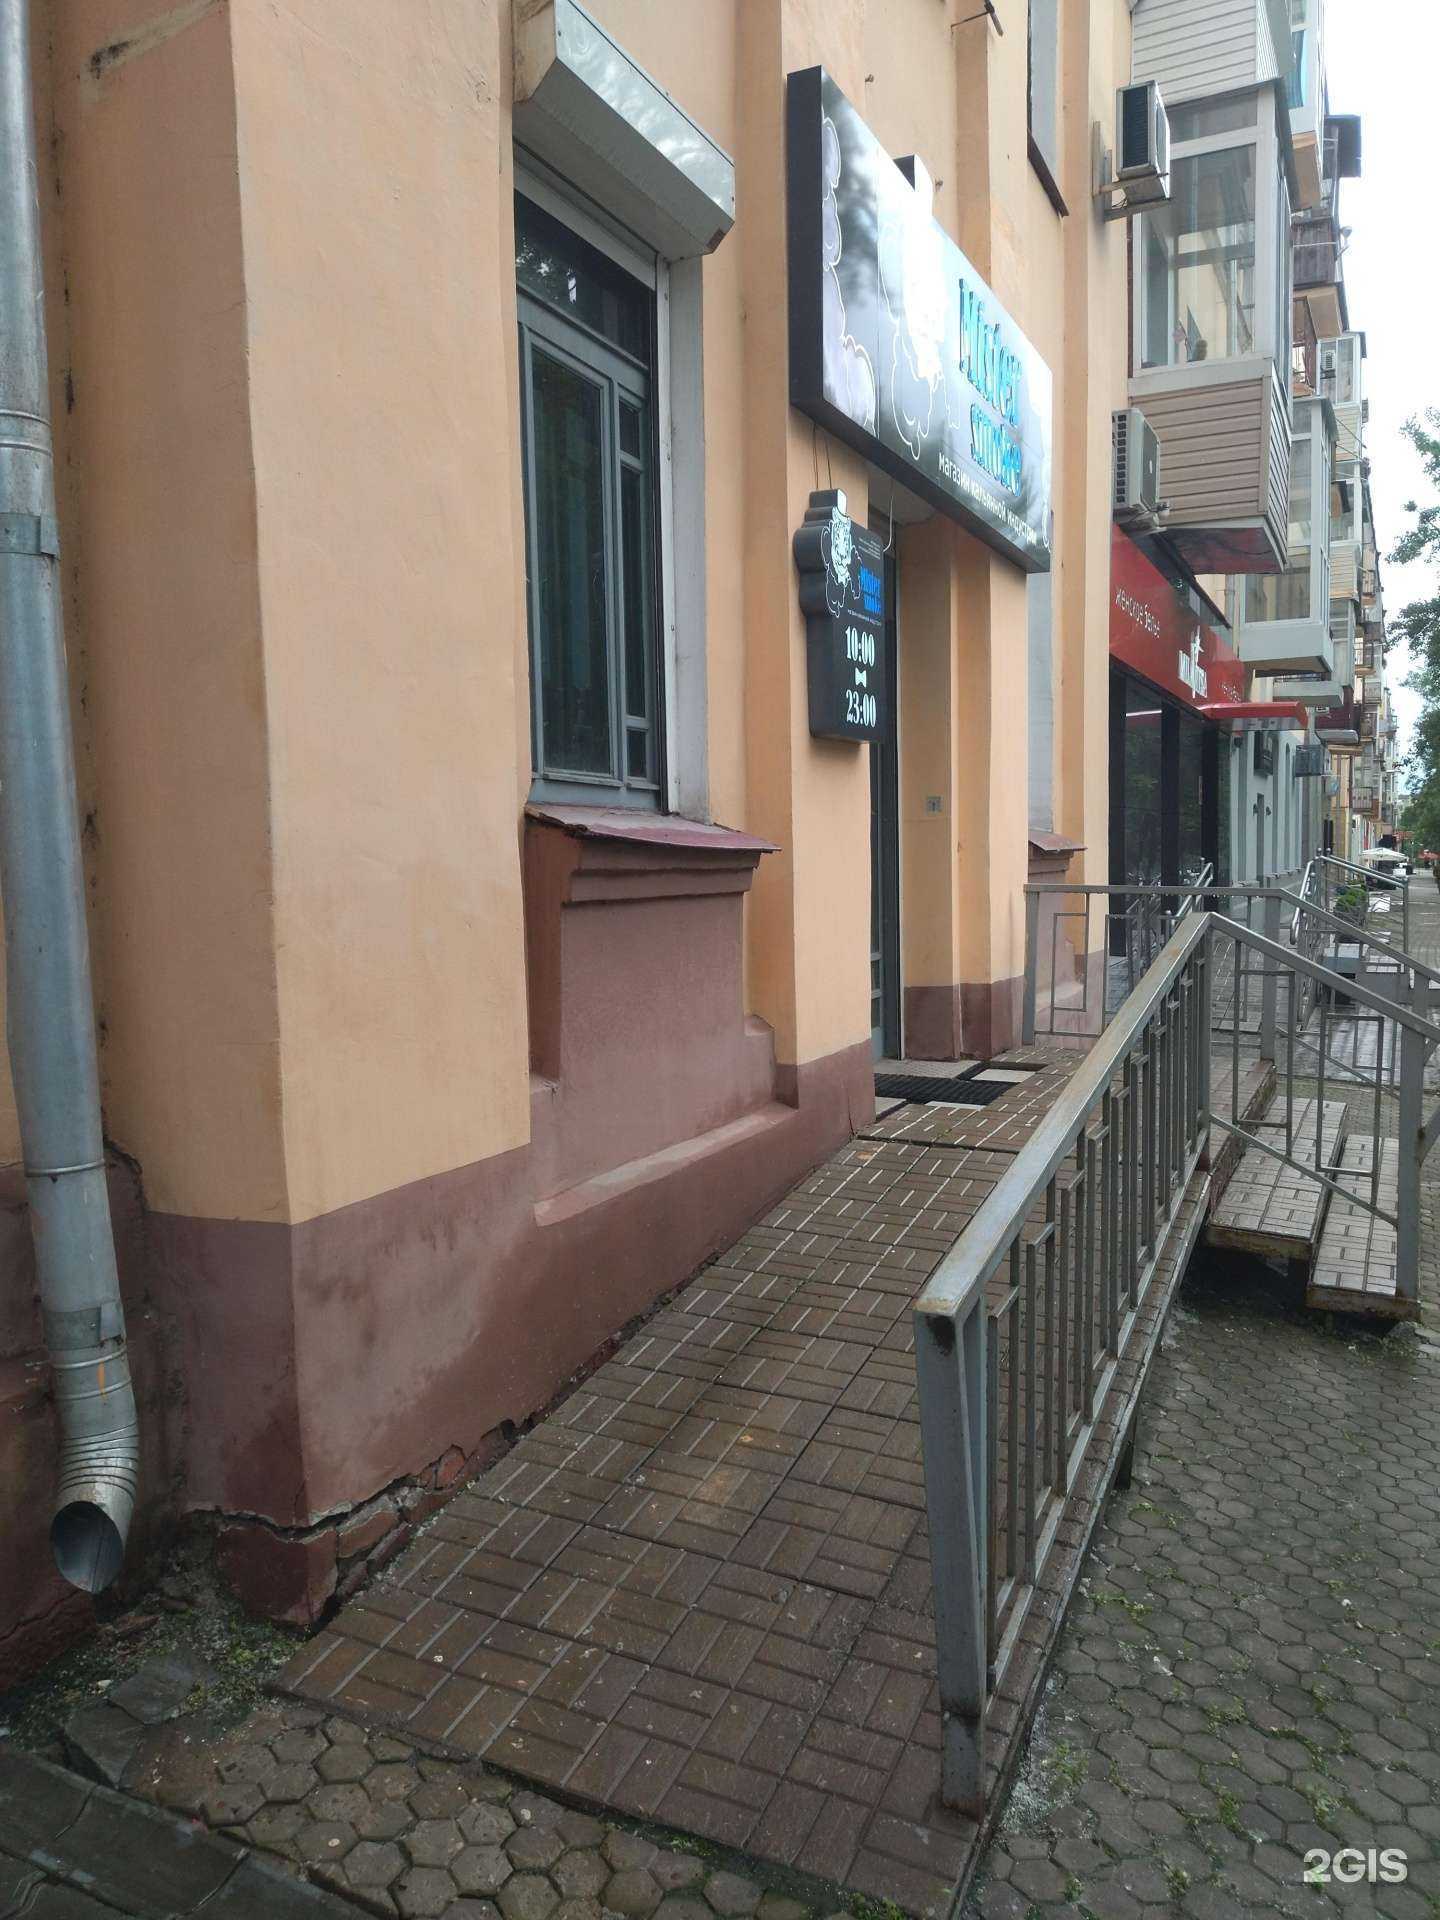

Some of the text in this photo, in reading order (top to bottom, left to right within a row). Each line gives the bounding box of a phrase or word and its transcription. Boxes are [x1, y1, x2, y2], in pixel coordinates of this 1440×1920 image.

[939, 452, 970, 493] магазин
[1115, 588, 1143, 625] женское
[845, 625, 875, 667] 10:00
[845, 689, 876, 727] 23:00
